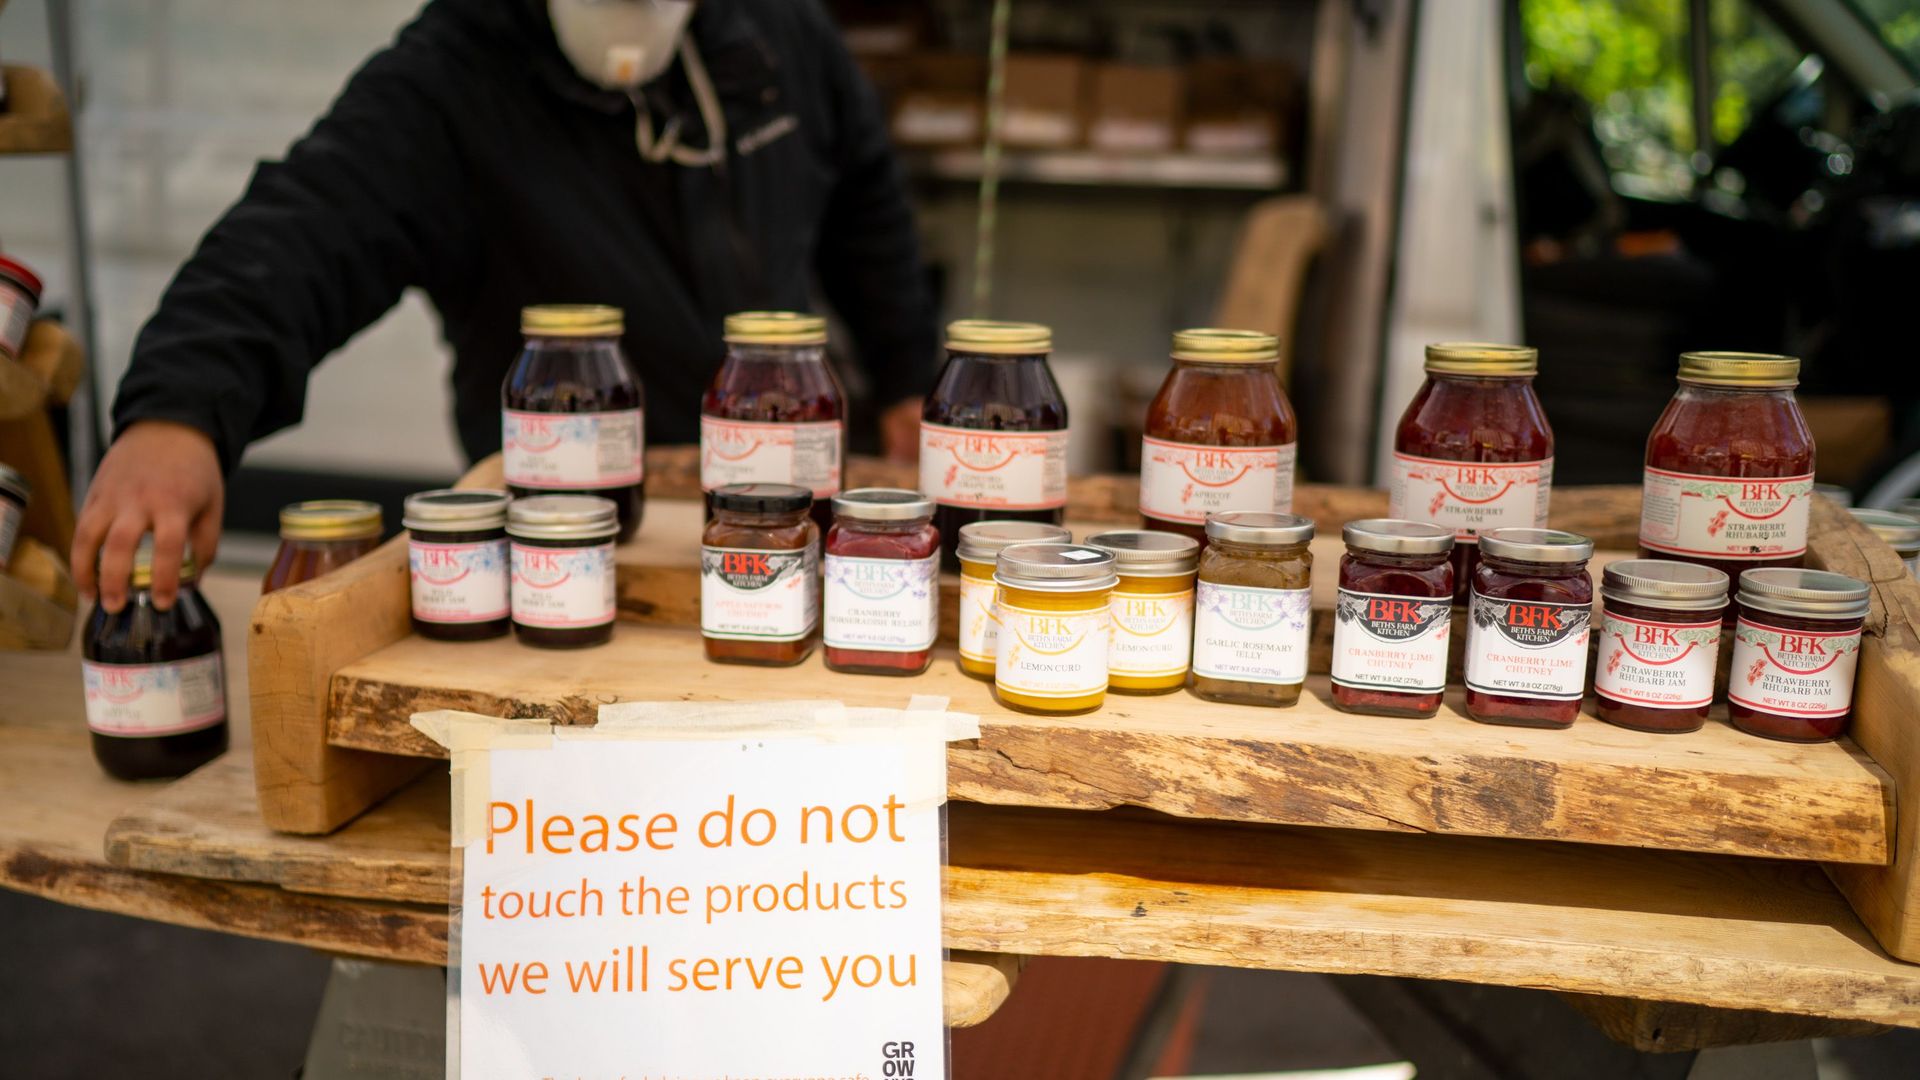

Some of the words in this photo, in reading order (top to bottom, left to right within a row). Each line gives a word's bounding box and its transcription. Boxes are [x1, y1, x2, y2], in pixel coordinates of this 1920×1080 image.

[1196, 451, 1234, 469] BFK
[1456, 467, 1498, 486] BFK
[1195, 491, 1230, 500] APRICOT
[1741, 483, 1782, 500] BFK
[1203, 499, 1220, 507] JAM
[1445, 505, 1504, 515] STRAWBERRY
[1465, 515, 1483, 523] JAM
[1727, 522, 1786, 532] STRAWBERRY
[1771, 531, 1787, 539] JAM
[723, 552, 773, 576] BFK
[855, 564, 896, 582] BFK
[1126, 600, 1166, 617] BFK
[1231, 592, 1274, 612] BFK
[848, 608, 902, 618] CRANBERRY
[1368, 598, 1423, 624] BFK
[1508, 604, 1564, 631] BFK
[1028, 616, 1073, 635] BFK
[1377, 628, 1410, 637] KITCHEN
[1396, 622, 1417, 631] FARM
[1536, 627, 1558, 637] FARM
[1516, 633, 1550, 643] KITCHEN
[1634, 625, 1680, 647] BFK
[1116, 643, 1148, 652] LEMON
[1150, 644, 1173, 652] CURD
[1206, 638, 1241, 649] GARLIC
[1242, 641, 1294, 652] ROSEMARY
[1658, 645, 1679, 654] FARM
[1778, 634, 1827, 655] BFK
[1235, 650, 1263, 660] JELLY
[1348, 647, 1407, 660] CRANBERRY
[1410, 653, 1434, 662] LIME
[1486, 652, 1547, 666] CRANBERRY
[1550, 658, 1574, 668] LIME
[1638, 650, 1673, 659] KITCHEN
[1803, 654, 1825, 662] FARM
[1020, 661, 1053, 672] LEMON
[1055, 663, 1081, 672] CURD
[1366, 659, 1414, 670] CHUTNEY
[1505, 664, 1553, 676] CHUTNEY
[1783, 659, 1819, 668] KITCHEN
[1621, 664, 1686, 679] STRAWBERRY
[1493, 679, 1507, 687] NET
[1508, 680, 1519, 688] WT
[1619, 672, 1665, 686] RHUBARB
[1667, 679, 1686, 687] JAM
[1764, 673, 1831, 688] STRAWBERRY
[1619, 687, 1633, 695] NET
[1762, 681, 1811, 696] RHUBARB
[1813, 687, 1831, 696] JAM
[1762, 697, 1777, 705] NET
[485, 798, 678, 855] Please
[698, 794, 777, 848] do
[800, 794, 907, 845] not
[481, 878, 604, 920] touch
[619, 876, 690, 916] the
[706, 870, 907, 925] products
[479, 960, 549, 995] we
[565, 945, 649, 993] will
[668, 956, 804, 992] serve
[820, 953, 918, 1002] you
[882, 1041, 915, 1059] GR
[882, 1060, 915, 1077] OW
